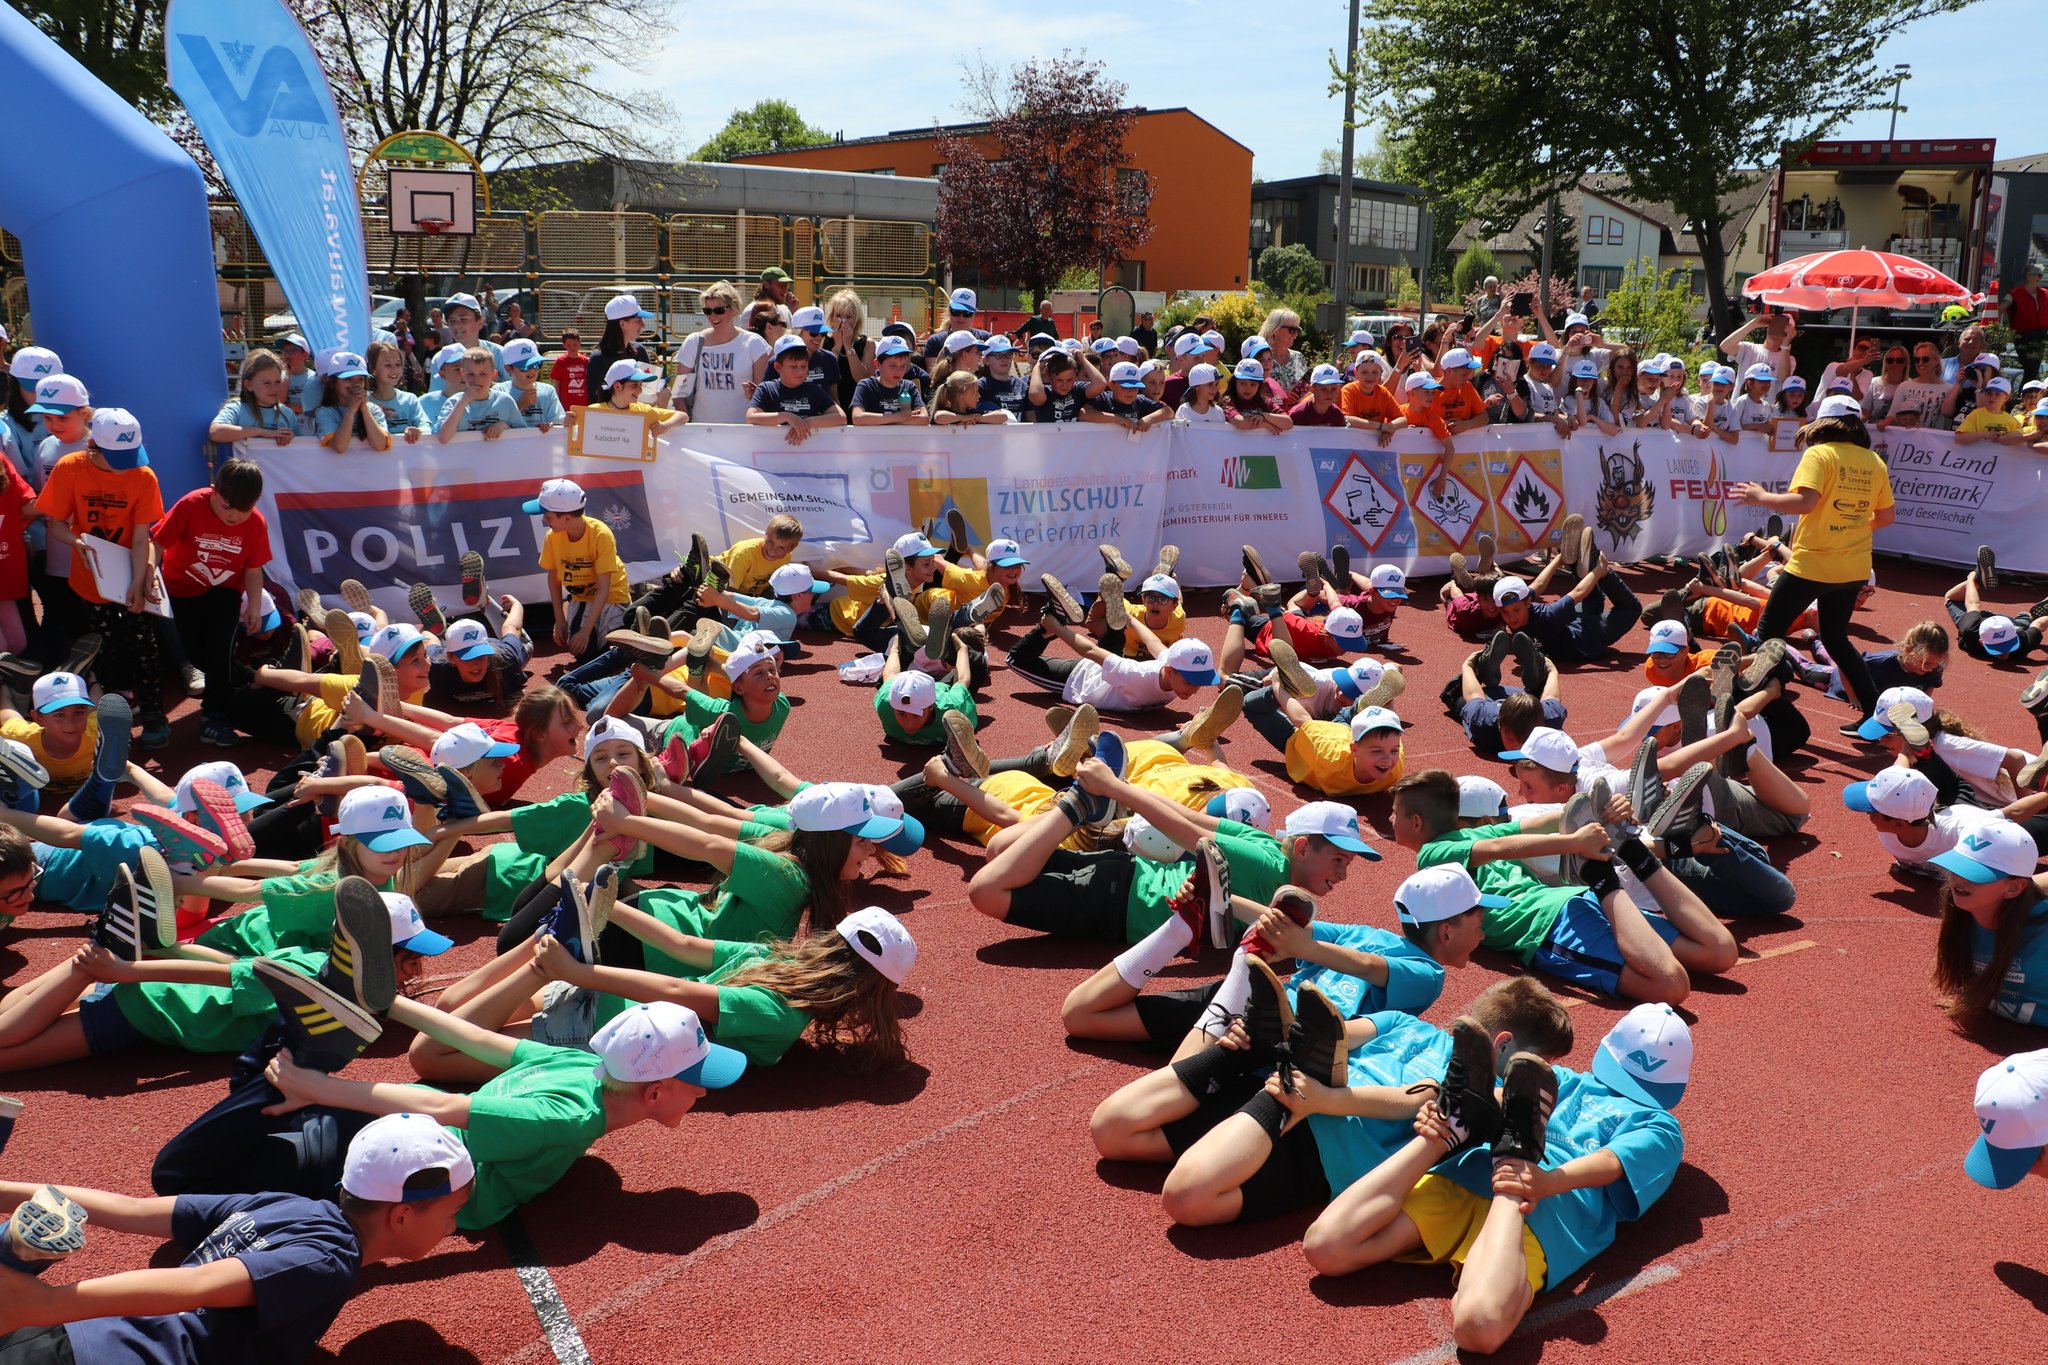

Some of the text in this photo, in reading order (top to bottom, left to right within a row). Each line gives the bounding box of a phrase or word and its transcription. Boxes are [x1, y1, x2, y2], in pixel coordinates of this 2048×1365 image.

[701, 351, 735, 371] SUM
[1666, 458, 1701, 475] LANDES
[1899, 443, 1998, 476] Das Land
[1889, 475, 1983, 504] Steiermark
[764, 503, 825, 514] in Österreich
[997, 484, 1144, 516] ZIVILSCHUTZ
[1178, 502, 1232, 513] ÖSTERREICH
[1234, 513, 1250, 522] FÜR
[1253, 513, 1289, 522] INNERES
[1895, 507, 1975, 526] und Gesellschaft
[303, 514, 550, 575] POLIZ
